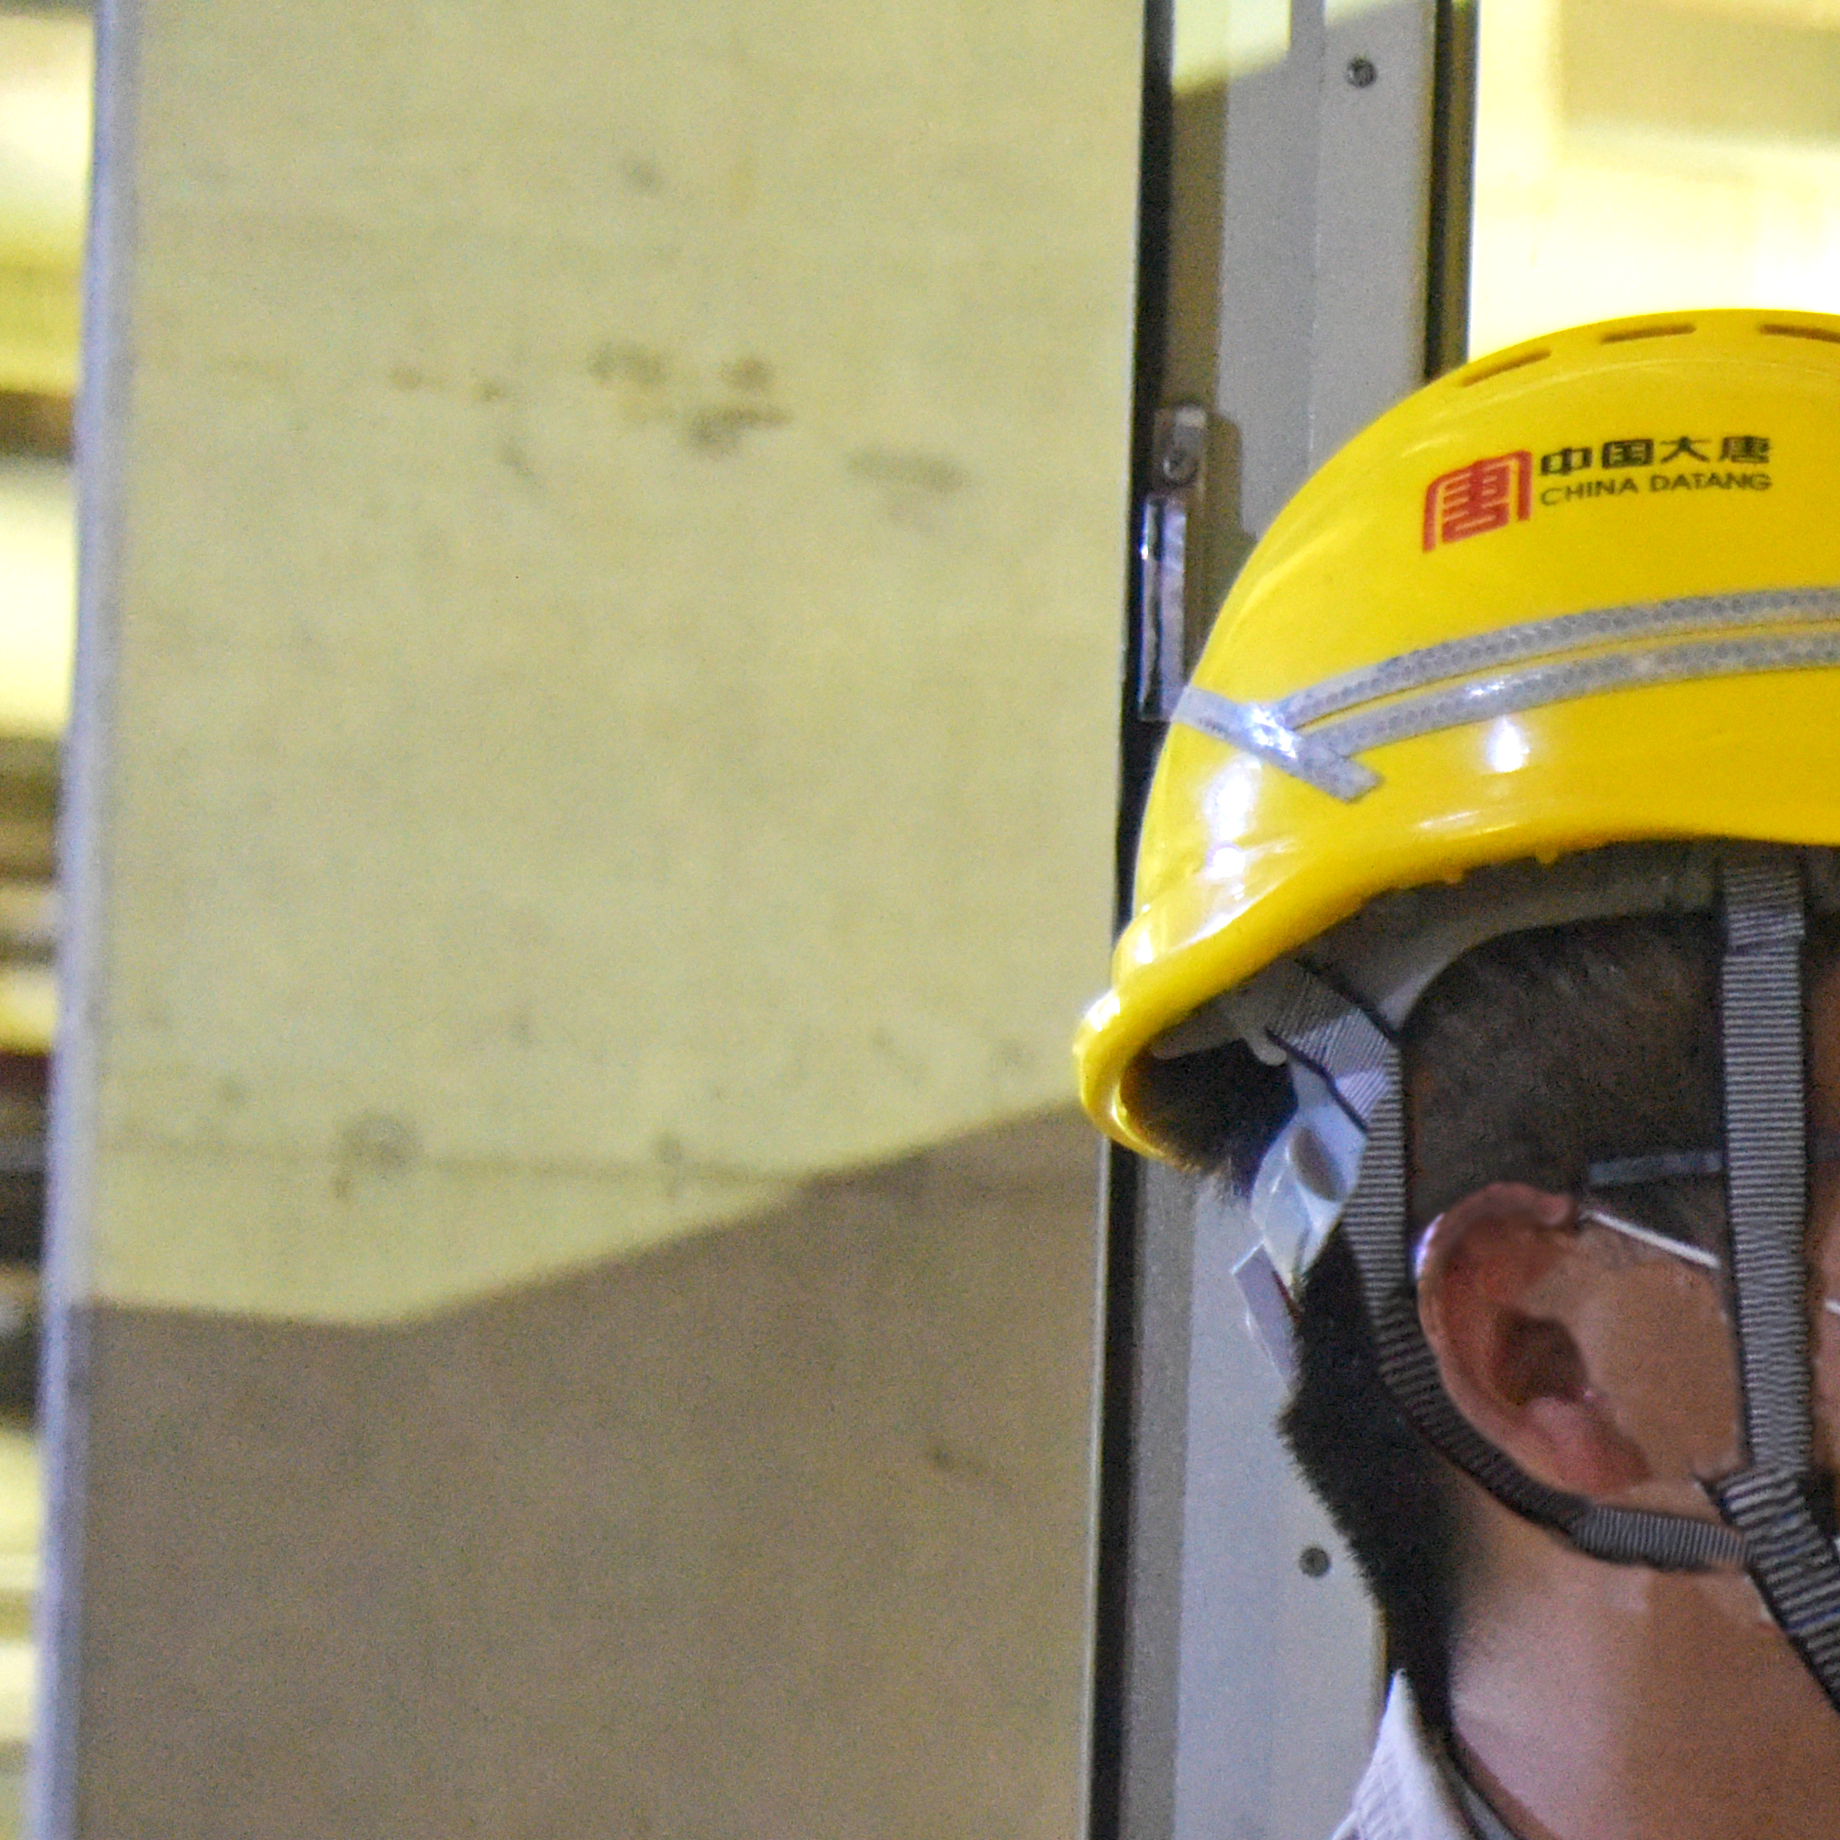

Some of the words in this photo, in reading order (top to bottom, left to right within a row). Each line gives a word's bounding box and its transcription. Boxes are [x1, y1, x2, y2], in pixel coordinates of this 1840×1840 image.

[1540, 436, 1770, 476] 中国大唐
[1541, 477, 1639, 507] CHINA
[1651, 473, 1772, 493] DATANG
